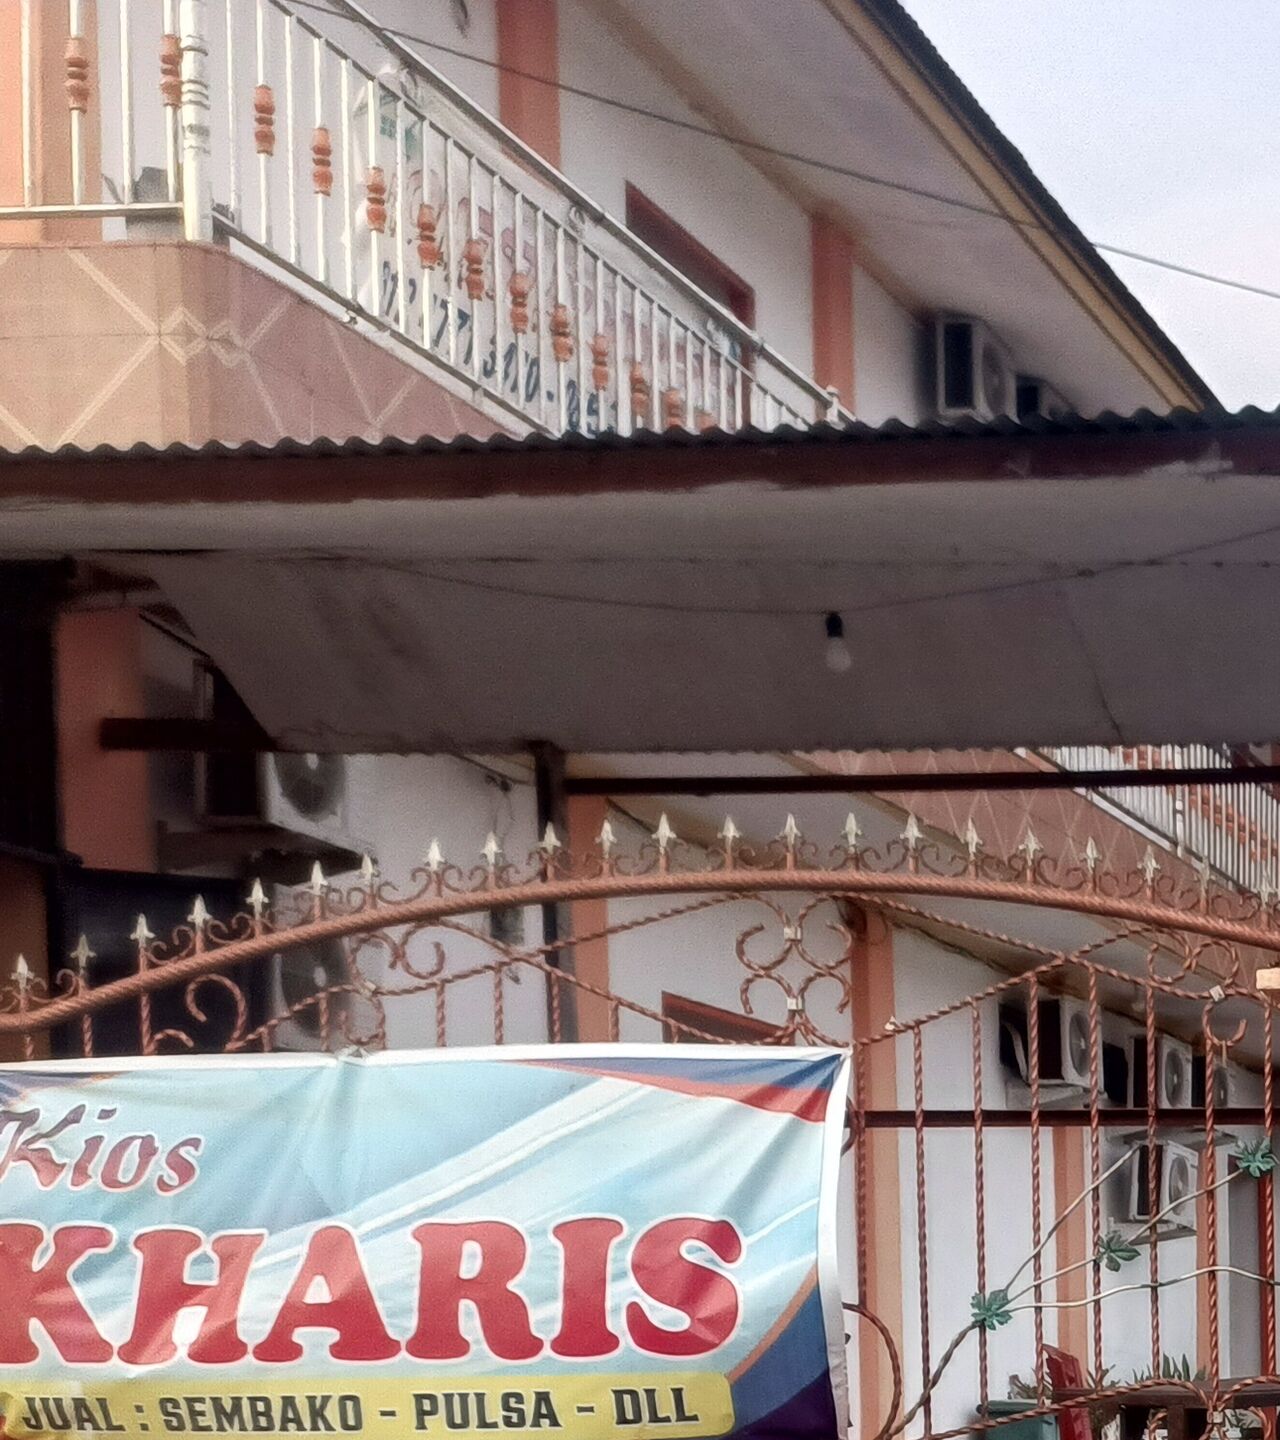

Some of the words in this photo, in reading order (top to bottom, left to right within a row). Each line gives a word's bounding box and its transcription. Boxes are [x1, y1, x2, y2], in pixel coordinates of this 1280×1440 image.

[0, 1104, 202, 1193] Kios
[0, 1217, 743, 1365] KHARIS
[23, 1397, 125, 1432] JUAL
[160, 1393, 363, 1433] SEMBAKO
[414, 1389, 562, 1430] PULSA
[613, 1385, 699, 1424] DLL
